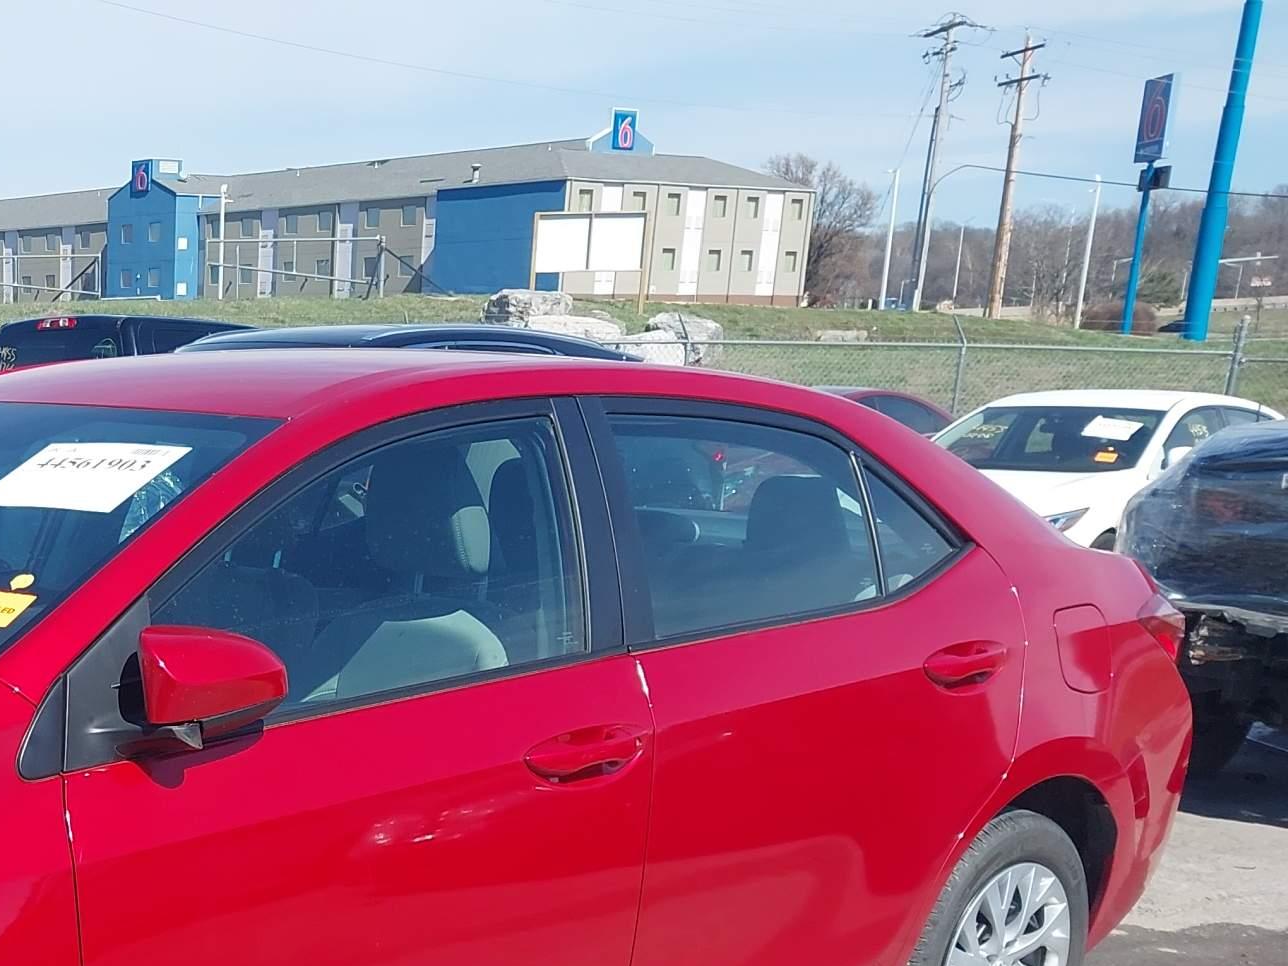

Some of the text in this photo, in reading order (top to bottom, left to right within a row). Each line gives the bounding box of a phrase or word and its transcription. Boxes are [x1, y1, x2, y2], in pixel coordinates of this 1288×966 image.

[618, 116, 633, 149] 6
[136, 163, 148, 191] 6
[37, 456, 152, 473] 44561903
